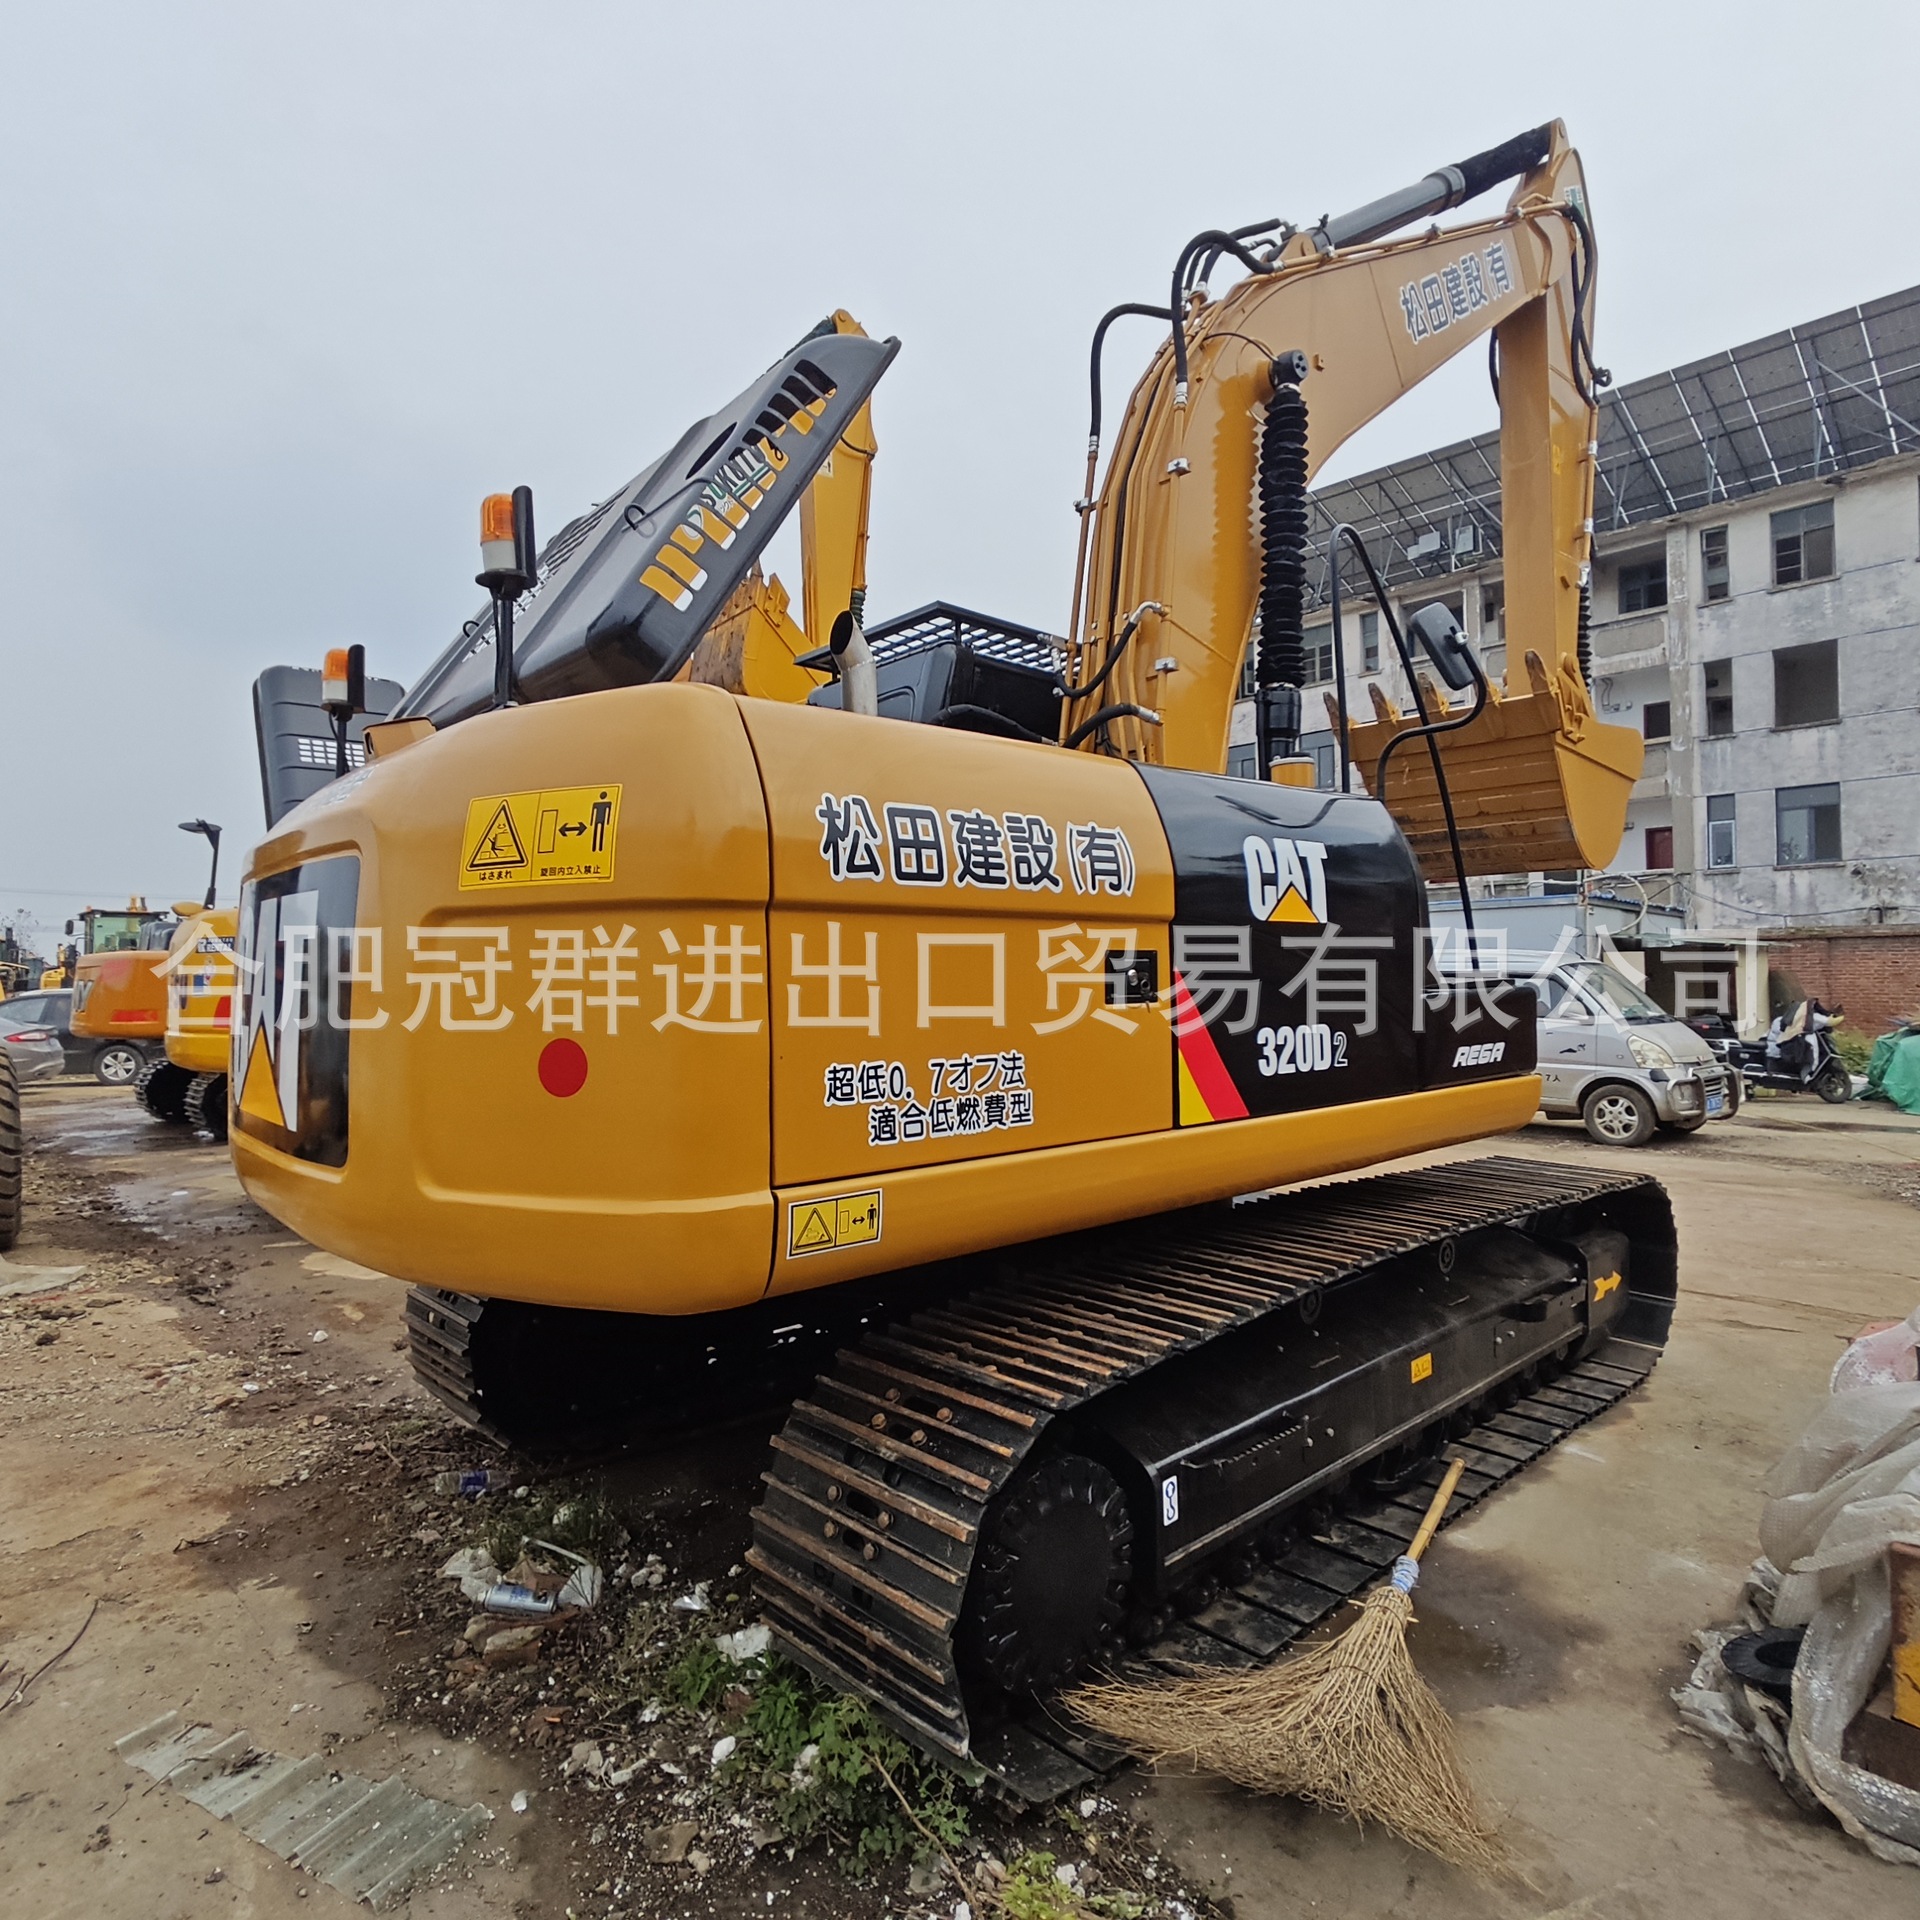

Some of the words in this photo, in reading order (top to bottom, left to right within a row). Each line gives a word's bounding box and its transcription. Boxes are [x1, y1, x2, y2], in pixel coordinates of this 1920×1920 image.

[479, 870, 512, 881] はさまれ
[816, 794, 1135, 895] 松田建設(有)
[1243, 836, 1328, 923] CAT
[869, 1092, 1032, 1143] 適合低燃費型
